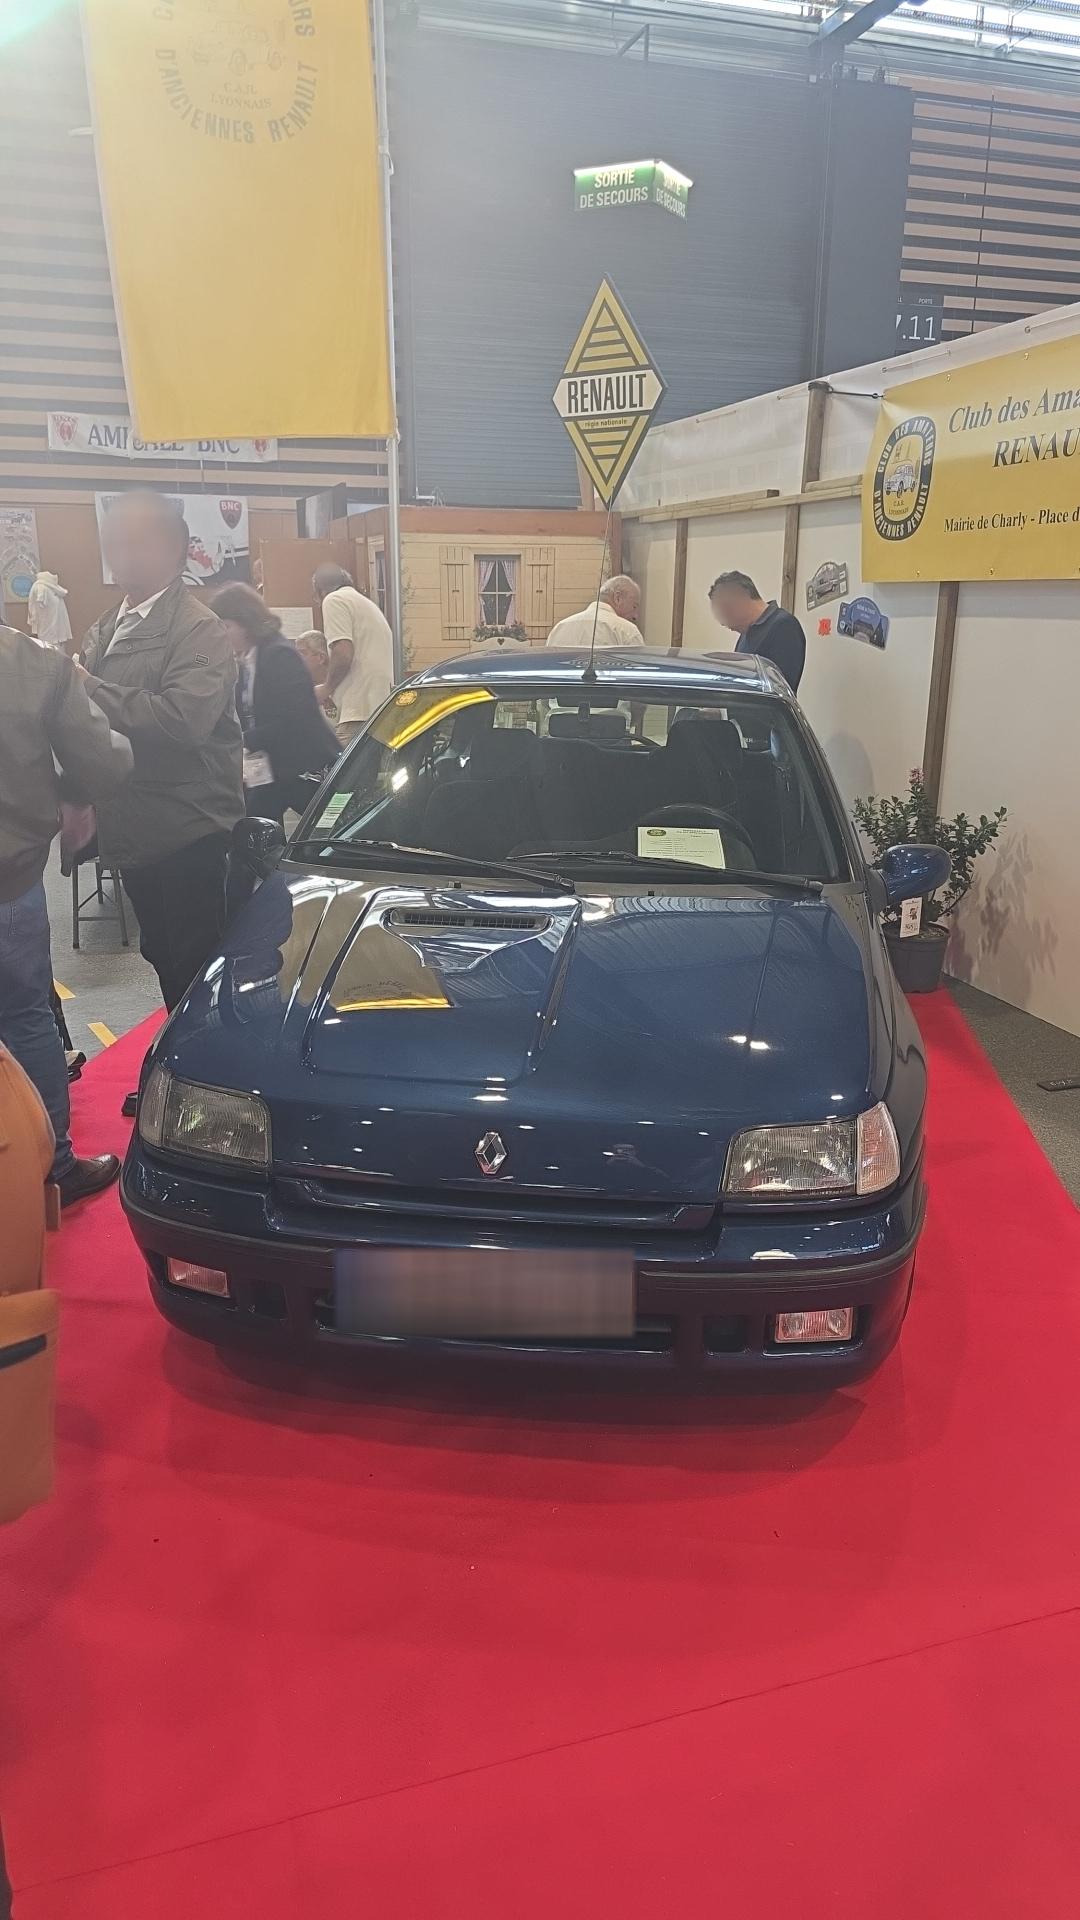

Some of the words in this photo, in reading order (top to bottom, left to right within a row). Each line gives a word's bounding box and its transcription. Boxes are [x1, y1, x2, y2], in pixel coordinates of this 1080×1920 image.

[266, 60, 319, 143] RENAULT
[594, 168, 635, 188] SORTIE
[580, 194, 594, 208] DE
[596, 186, 649, 207] SECOURS
[567, 373, 647, 414] RENAULT
[600, 418, 628, 427] nationale
[950, 402, 992, 433] Club
[997, 396, 1031, 424] des
[877, 444, 893, 473] CLUB
[894, 421, 910, 441] DES
[911, 419, 935, 467] AMATEURS
[221, 501, 240, 511] BNC
[906, 482, 929, 532] RENAULT
[943, 516, 975, 533] Mairie
[976, 515, 989, 530] de
[991, 511, 1028, 531] Charly
[1038, 508, 1069, 525] Place
